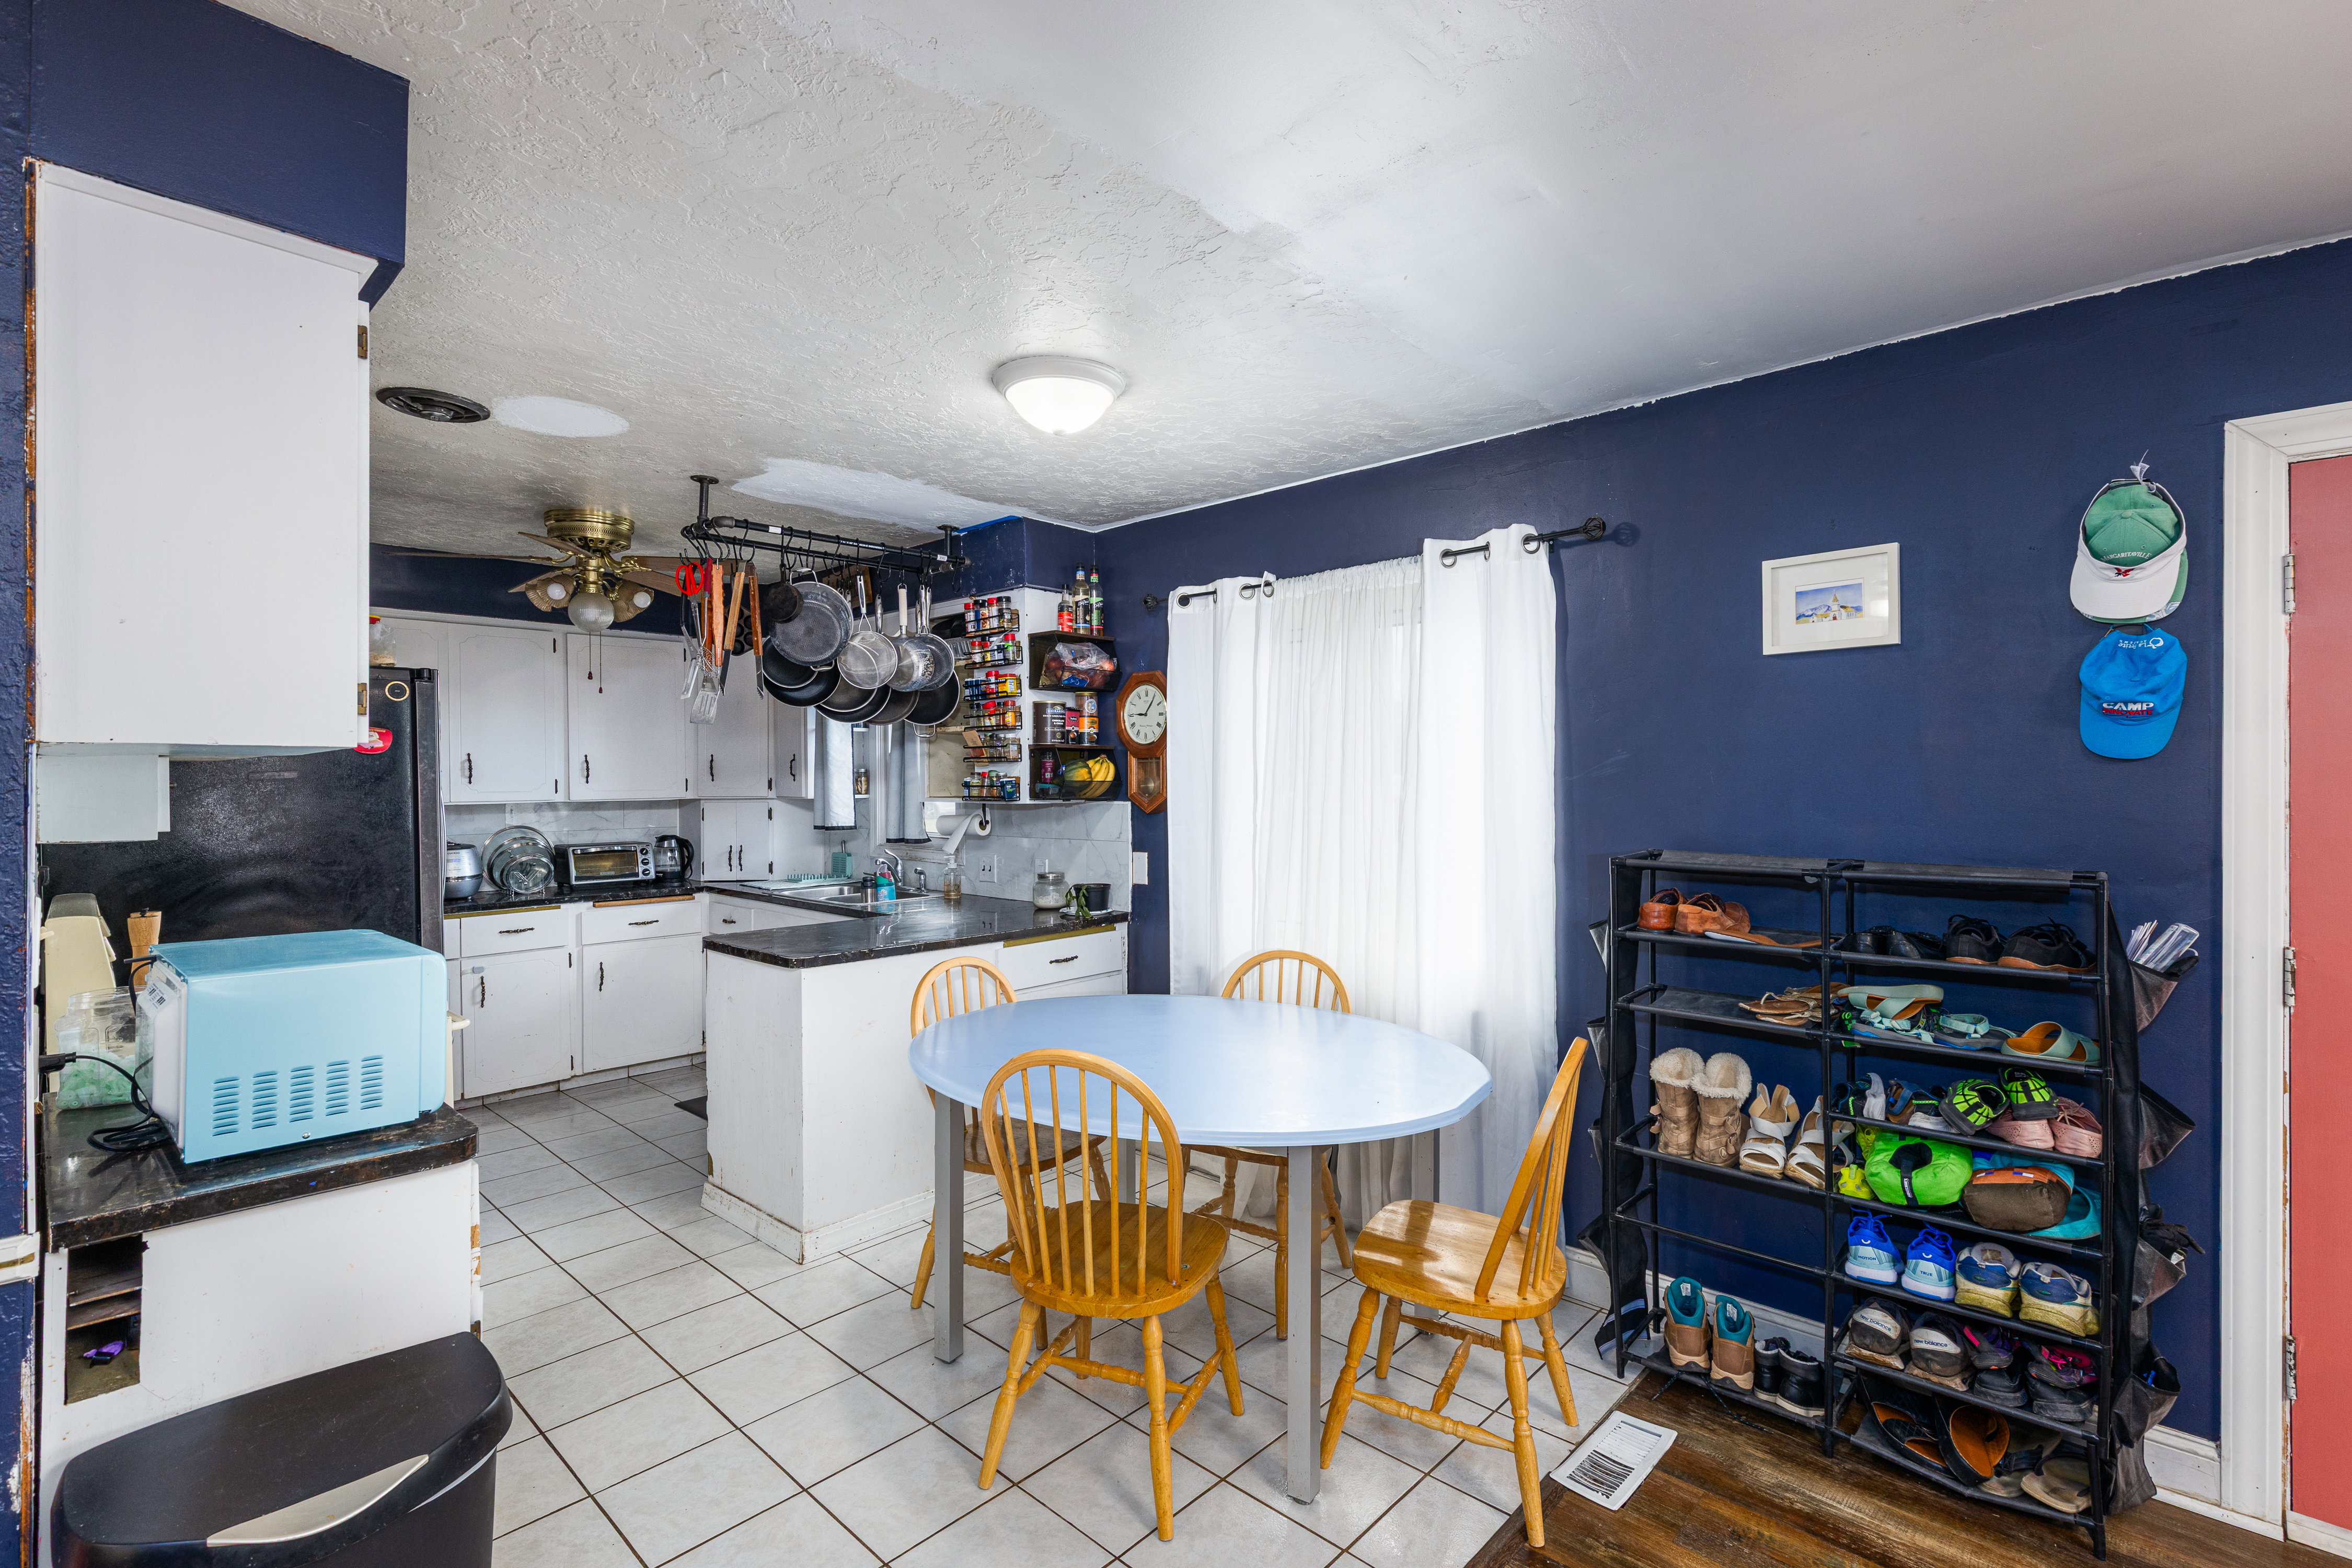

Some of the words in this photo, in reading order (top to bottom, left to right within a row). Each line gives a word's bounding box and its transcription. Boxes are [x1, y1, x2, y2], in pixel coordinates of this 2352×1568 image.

[2101, 551, 2152, 562] MARGARITAVILLE
[2102, 702, 2154, 710] CAMP
[1870, 1318, 1891, 1332] balance
[1924, 1339, 1947, 1347] balance
